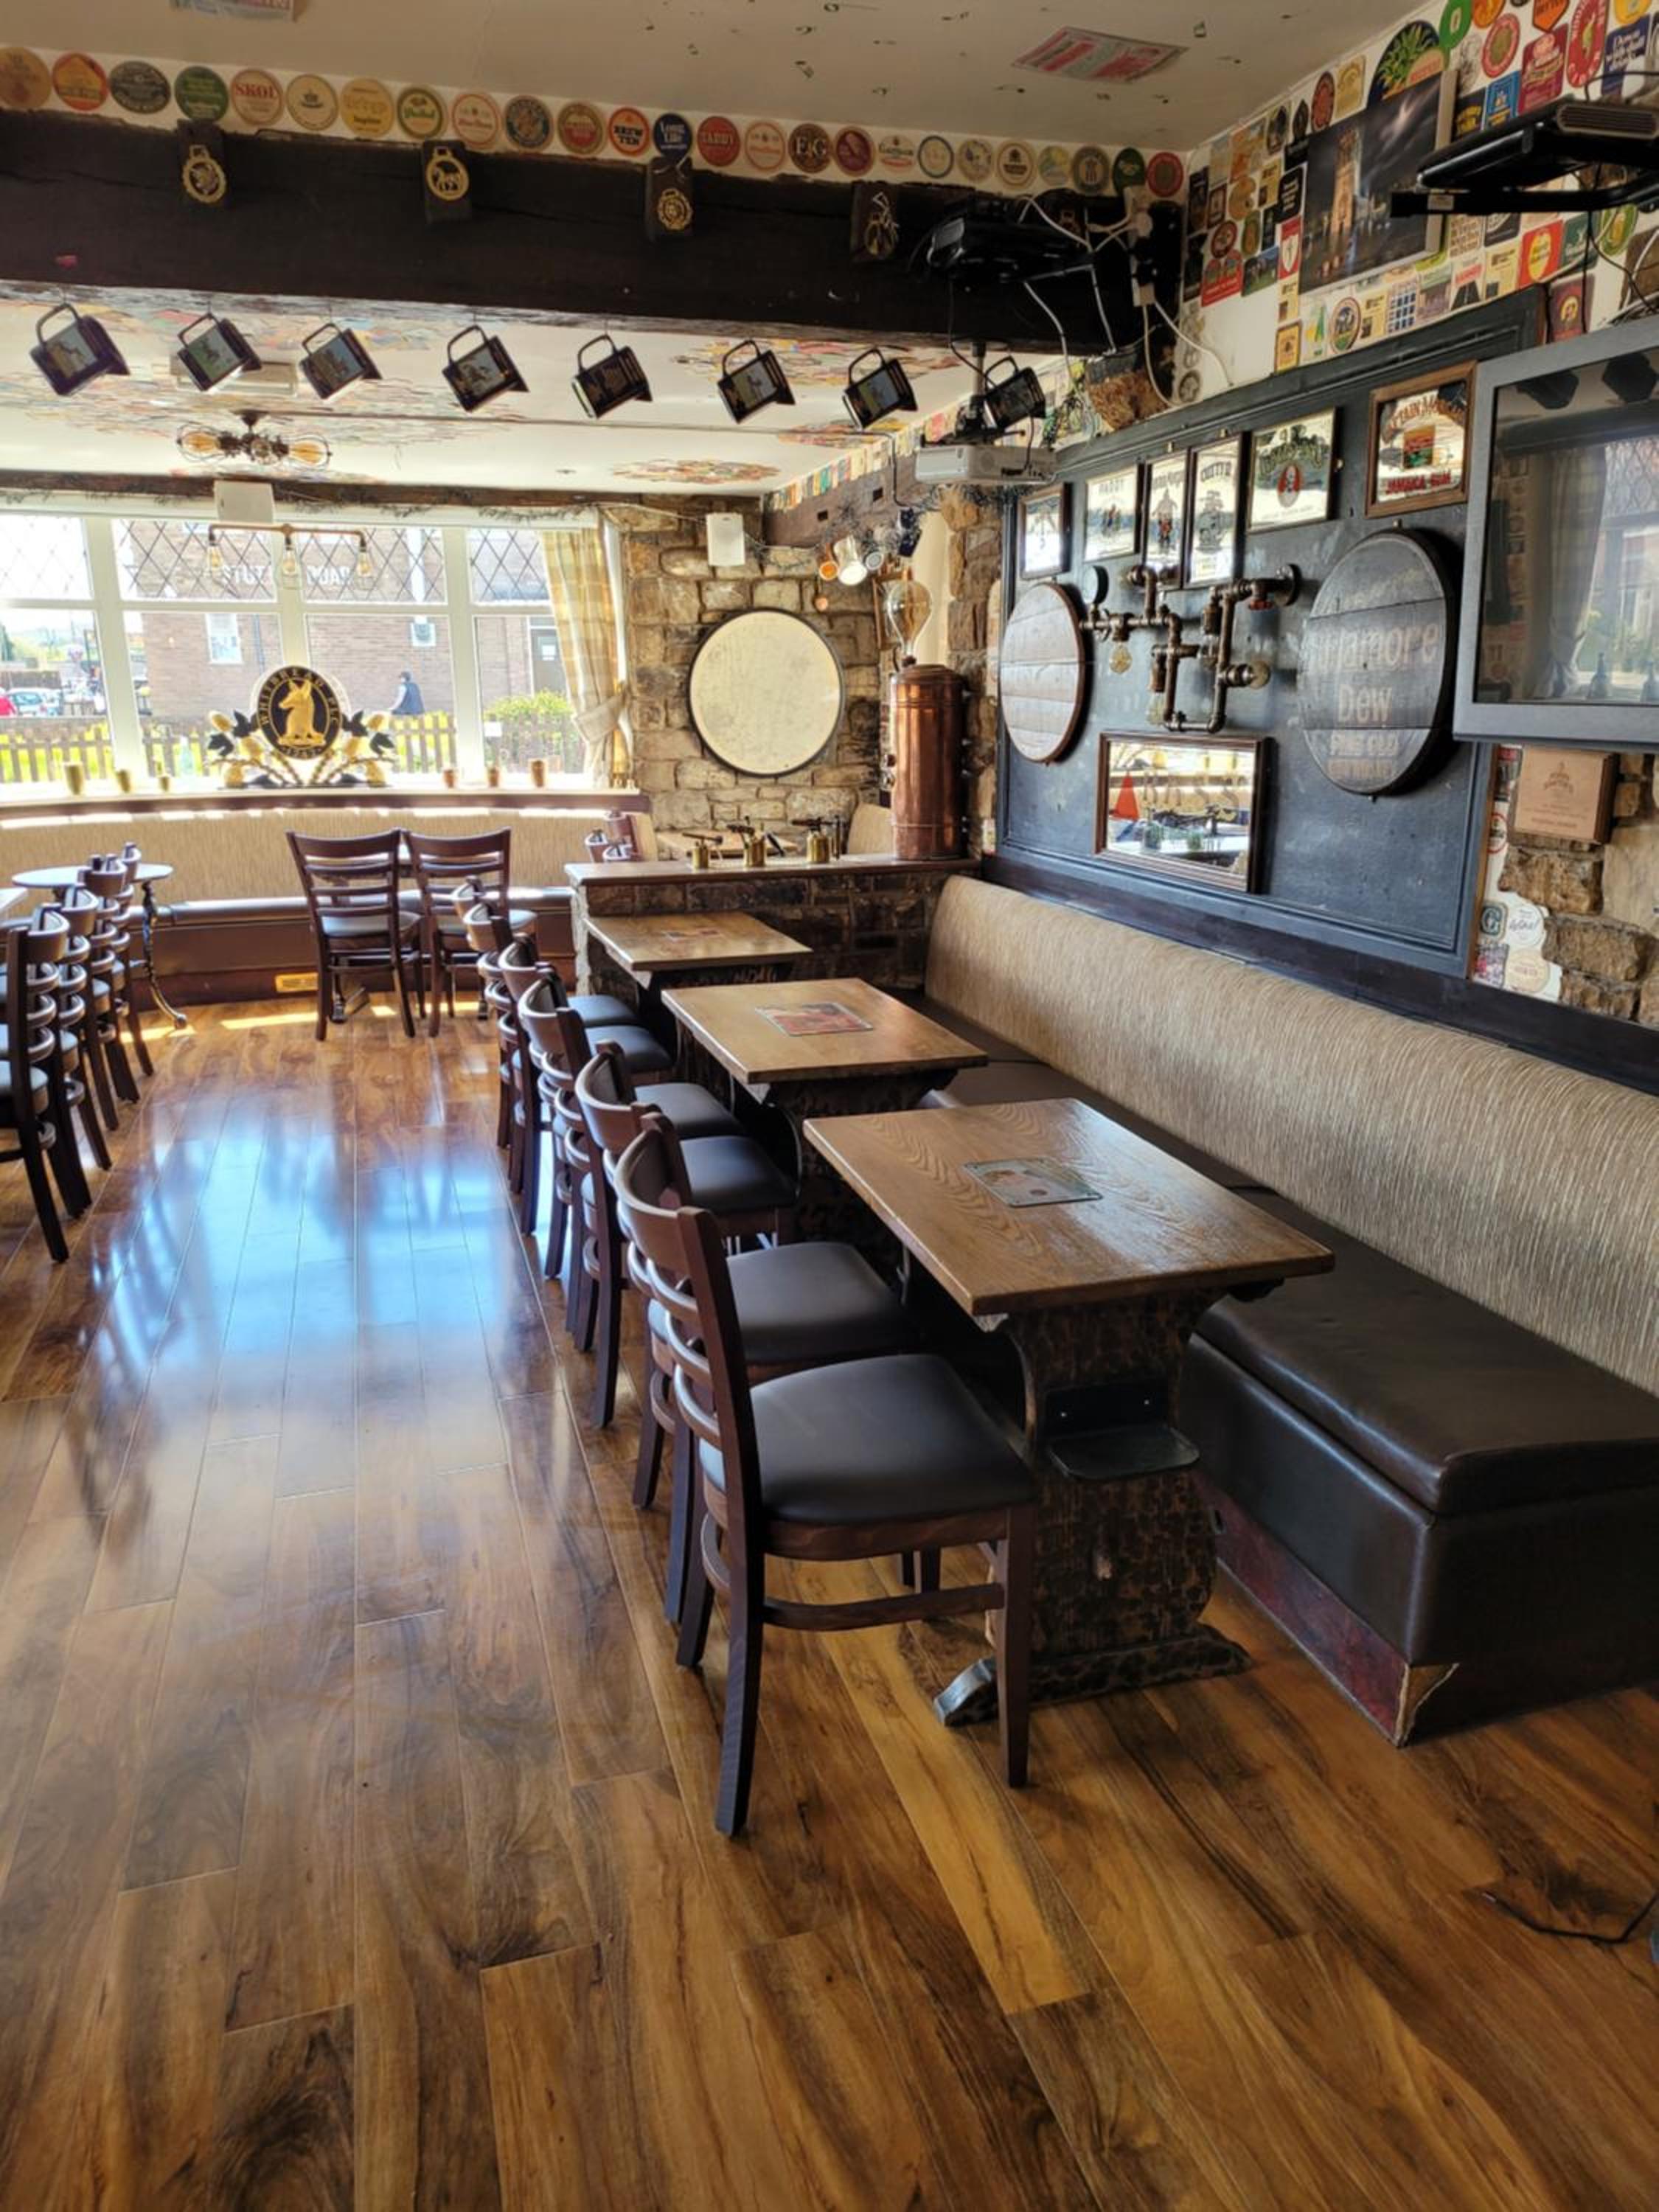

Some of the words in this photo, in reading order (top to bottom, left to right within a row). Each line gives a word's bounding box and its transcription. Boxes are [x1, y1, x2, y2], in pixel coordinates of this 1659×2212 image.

[235, 83, 277, 99] SKOL
[613, 125, 644, 137] BREW
[258, 667, 325, 725] WHITBREAD
[1338, 684, 1393, 725] Dew
